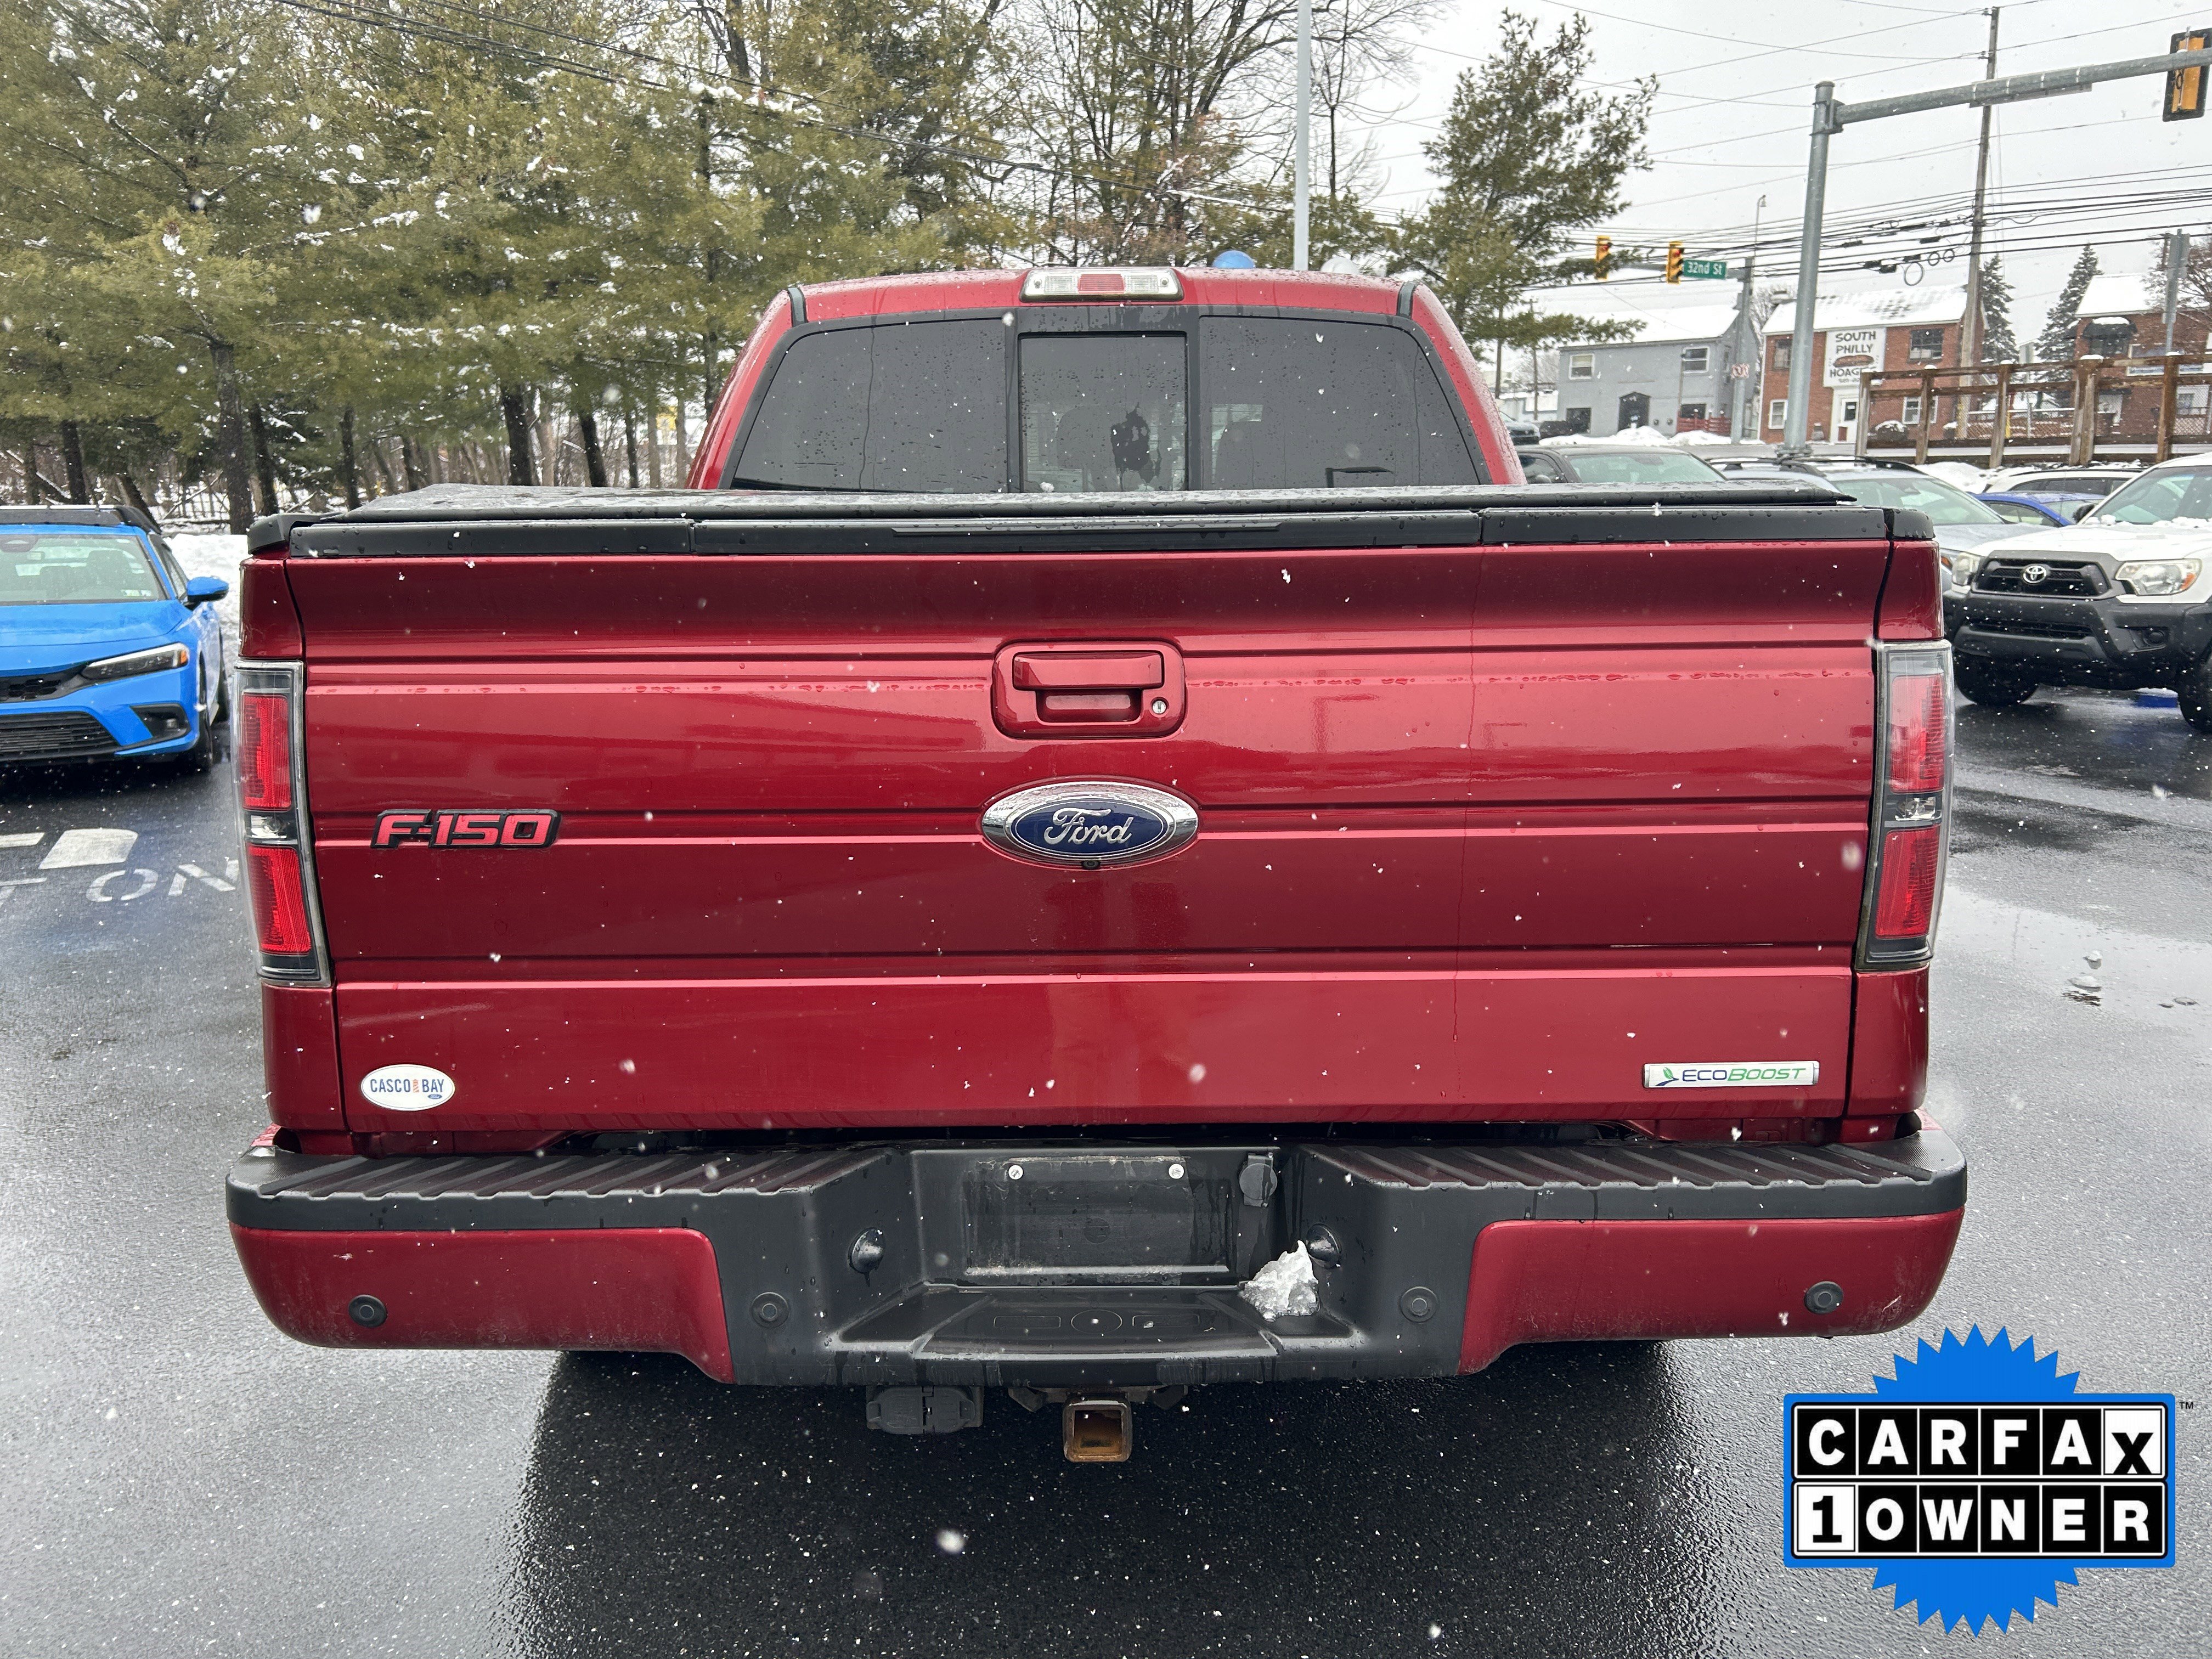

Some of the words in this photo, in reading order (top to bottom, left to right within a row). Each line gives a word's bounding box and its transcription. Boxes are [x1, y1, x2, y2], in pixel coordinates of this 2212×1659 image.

[1687, 261, 1710, 274] 32nd
[1713, 263, 1723, 275] St
[1835, 331, 1876, 342] SOUTH
[1836, 343, 1873, 354] PHILLY
[1830, 366, 1876, 377] HOAG
[370, 809, 561, 848] F-150
[1043, 808, 1133, 845] Ford
[1682, 1068, 1806, 1082] ECOBOOST
[370, 1079, 411, 1092] CASCO
[422, 1079, 444, 1092] BAY
